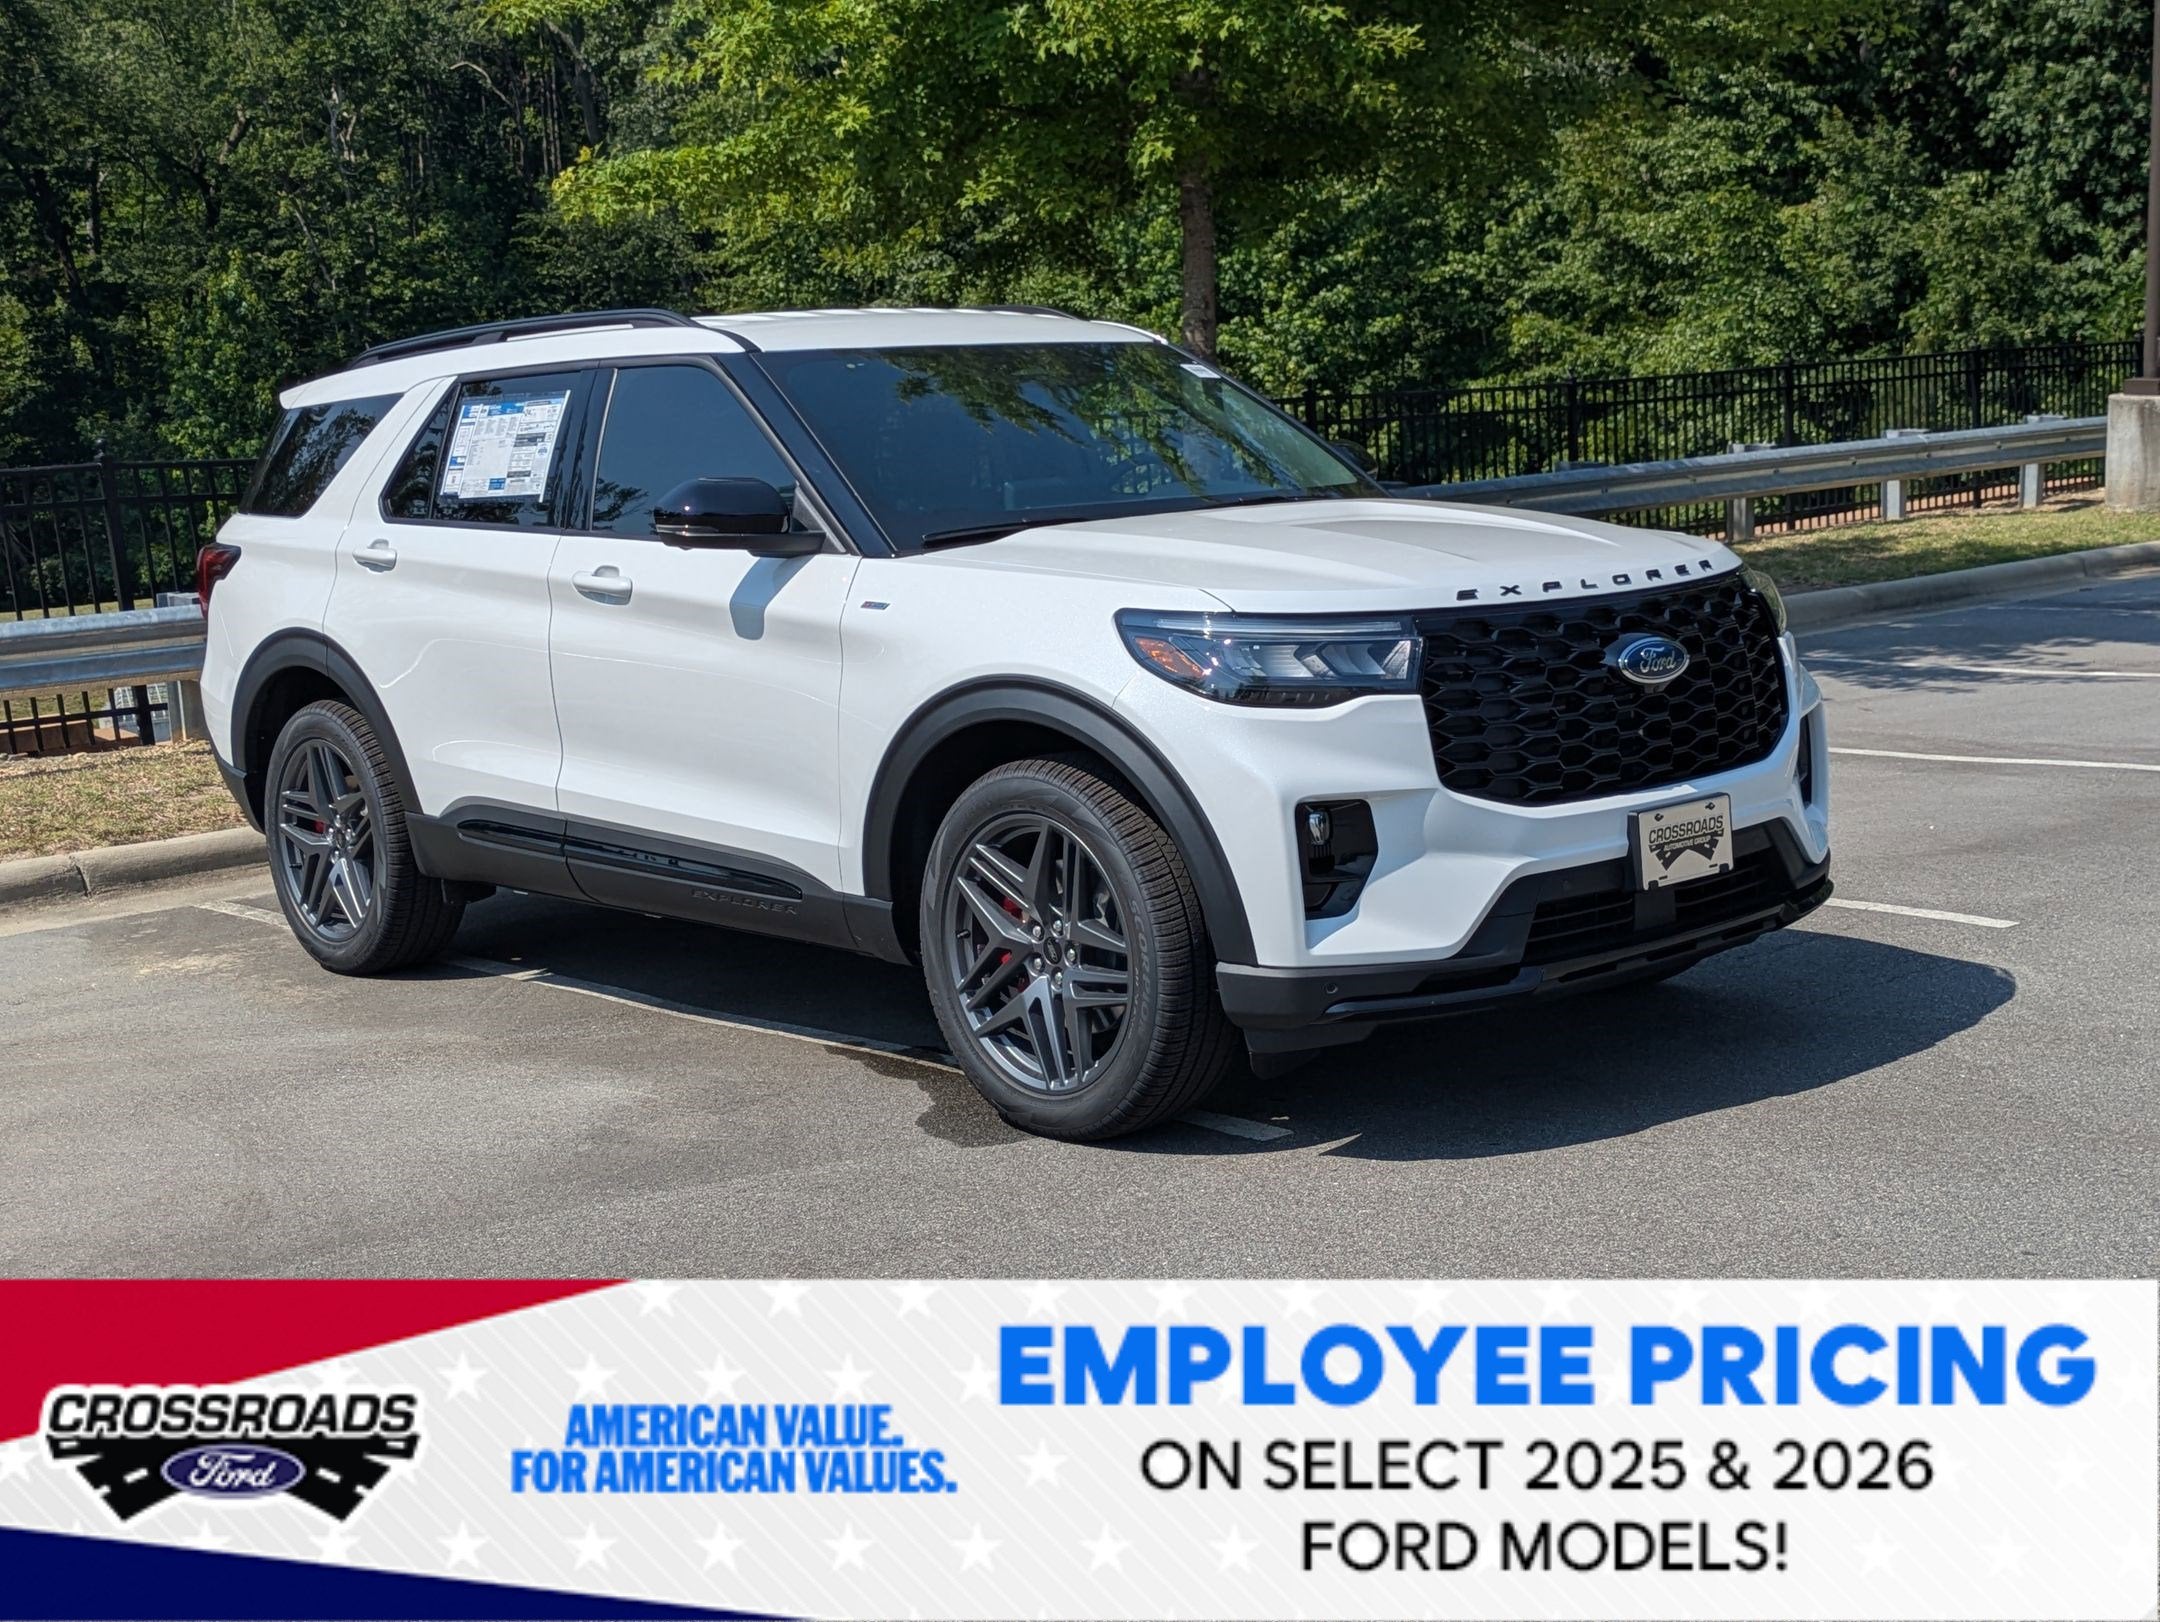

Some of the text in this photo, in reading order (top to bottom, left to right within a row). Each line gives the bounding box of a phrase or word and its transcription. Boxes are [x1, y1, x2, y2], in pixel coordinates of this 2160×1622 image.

[1456, 559, 1713, 601] EXPLORER
[1639, 646, 1678, 674] Ford
[1648, 814, 1724, 844] CROSSROADS
[690, 889, 798, 916] EXPLORER
